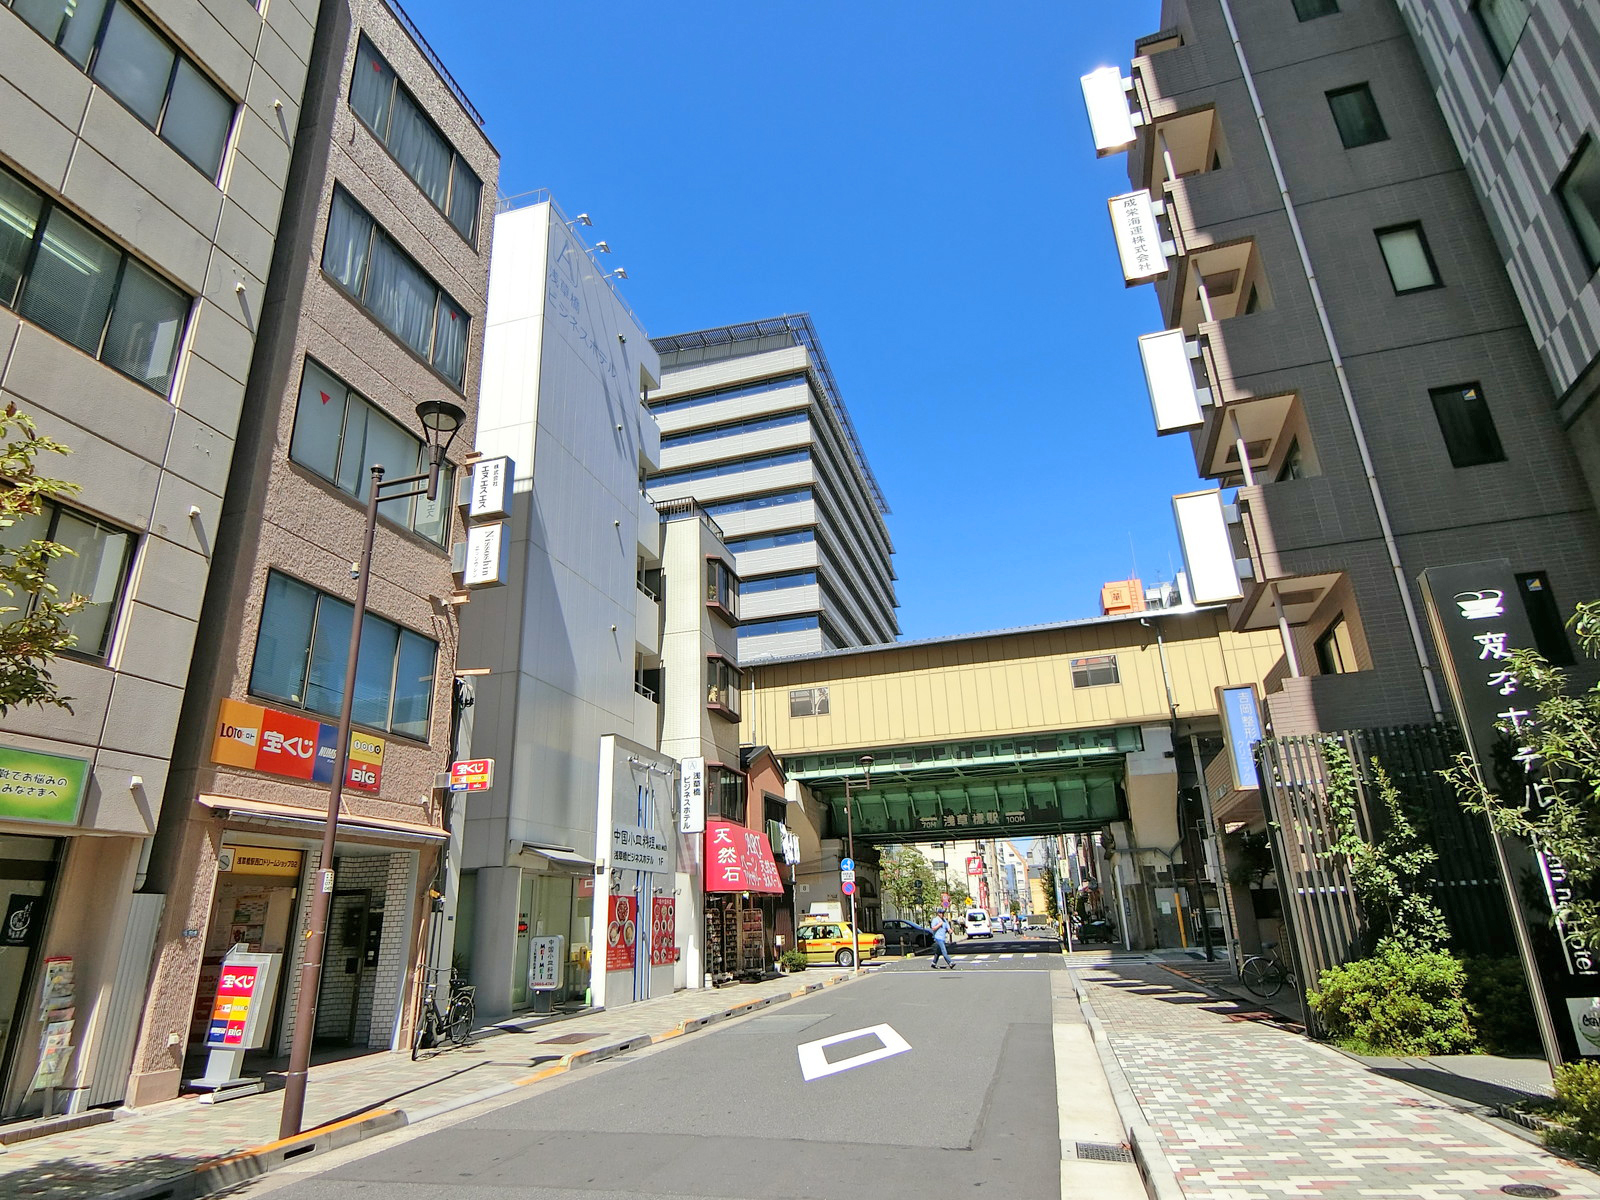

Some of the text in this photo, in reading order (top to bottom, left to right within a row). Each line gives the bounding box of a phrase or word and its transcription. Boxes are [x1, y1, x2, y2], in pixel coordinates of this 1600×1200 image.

[1124, 198, 1152, 272] 成栄海運株式会社
[550, 266, 580, 315] 浅草橋
[548, 287, 617, 378] ビジネスホテル
[482, 530, 495, 577] Nissoshin
[220, 722, 243, 738] LOTO
[262, 730, 314, 759] 宝くじ
[354, 740, 382, 755] toto
[350, 768, 376, 785] BIG
[456, 762, 484, 775] 宝くじ
[1, 783, 58, 798] みなさまへ
[693, 771, 701, 797] 浅草橋
[683, 775, 691, 830] ビジネスホテル
[921, 812, 1026, 829] 70M 浅草橋駅 100M
[613, 828, 656, 850] 中国小皿料理
[613, 850, 654, 865] 浅草橋ビジネスホテル
[713, 827, 741, 882] 天然石
[221, 974, 255, 988] 宝くじ
[227, 1028, 243, 1037] BIG
